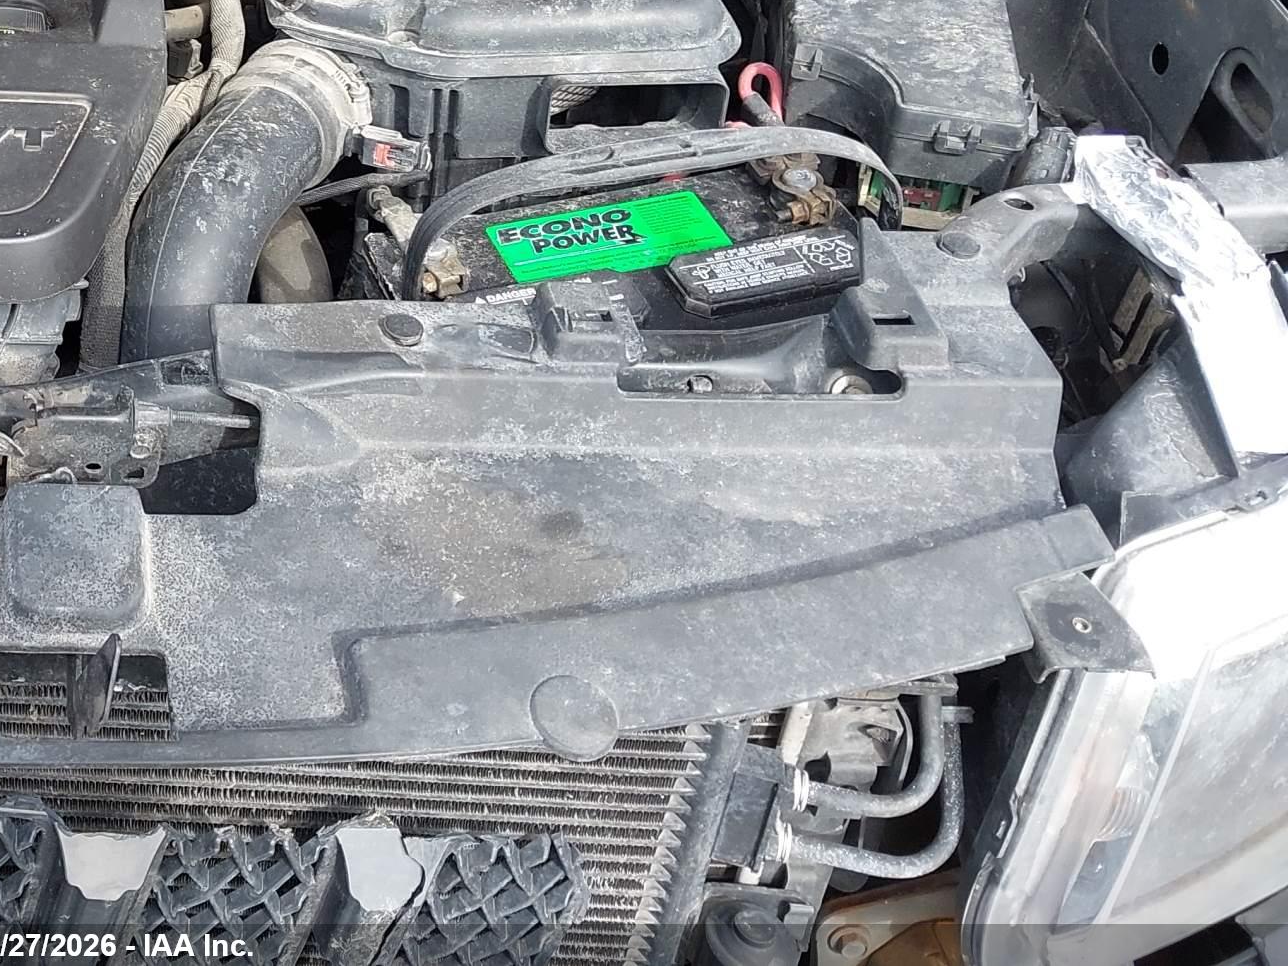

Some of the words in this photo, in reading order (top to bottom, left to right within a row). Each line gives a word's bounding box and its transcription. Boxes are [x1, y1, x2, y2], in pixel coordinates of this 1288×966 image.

[496, 208, 632, 245] ECONO
[532, 224, 644, 255] POWER
[485, 288, 537, 303] DANGER
